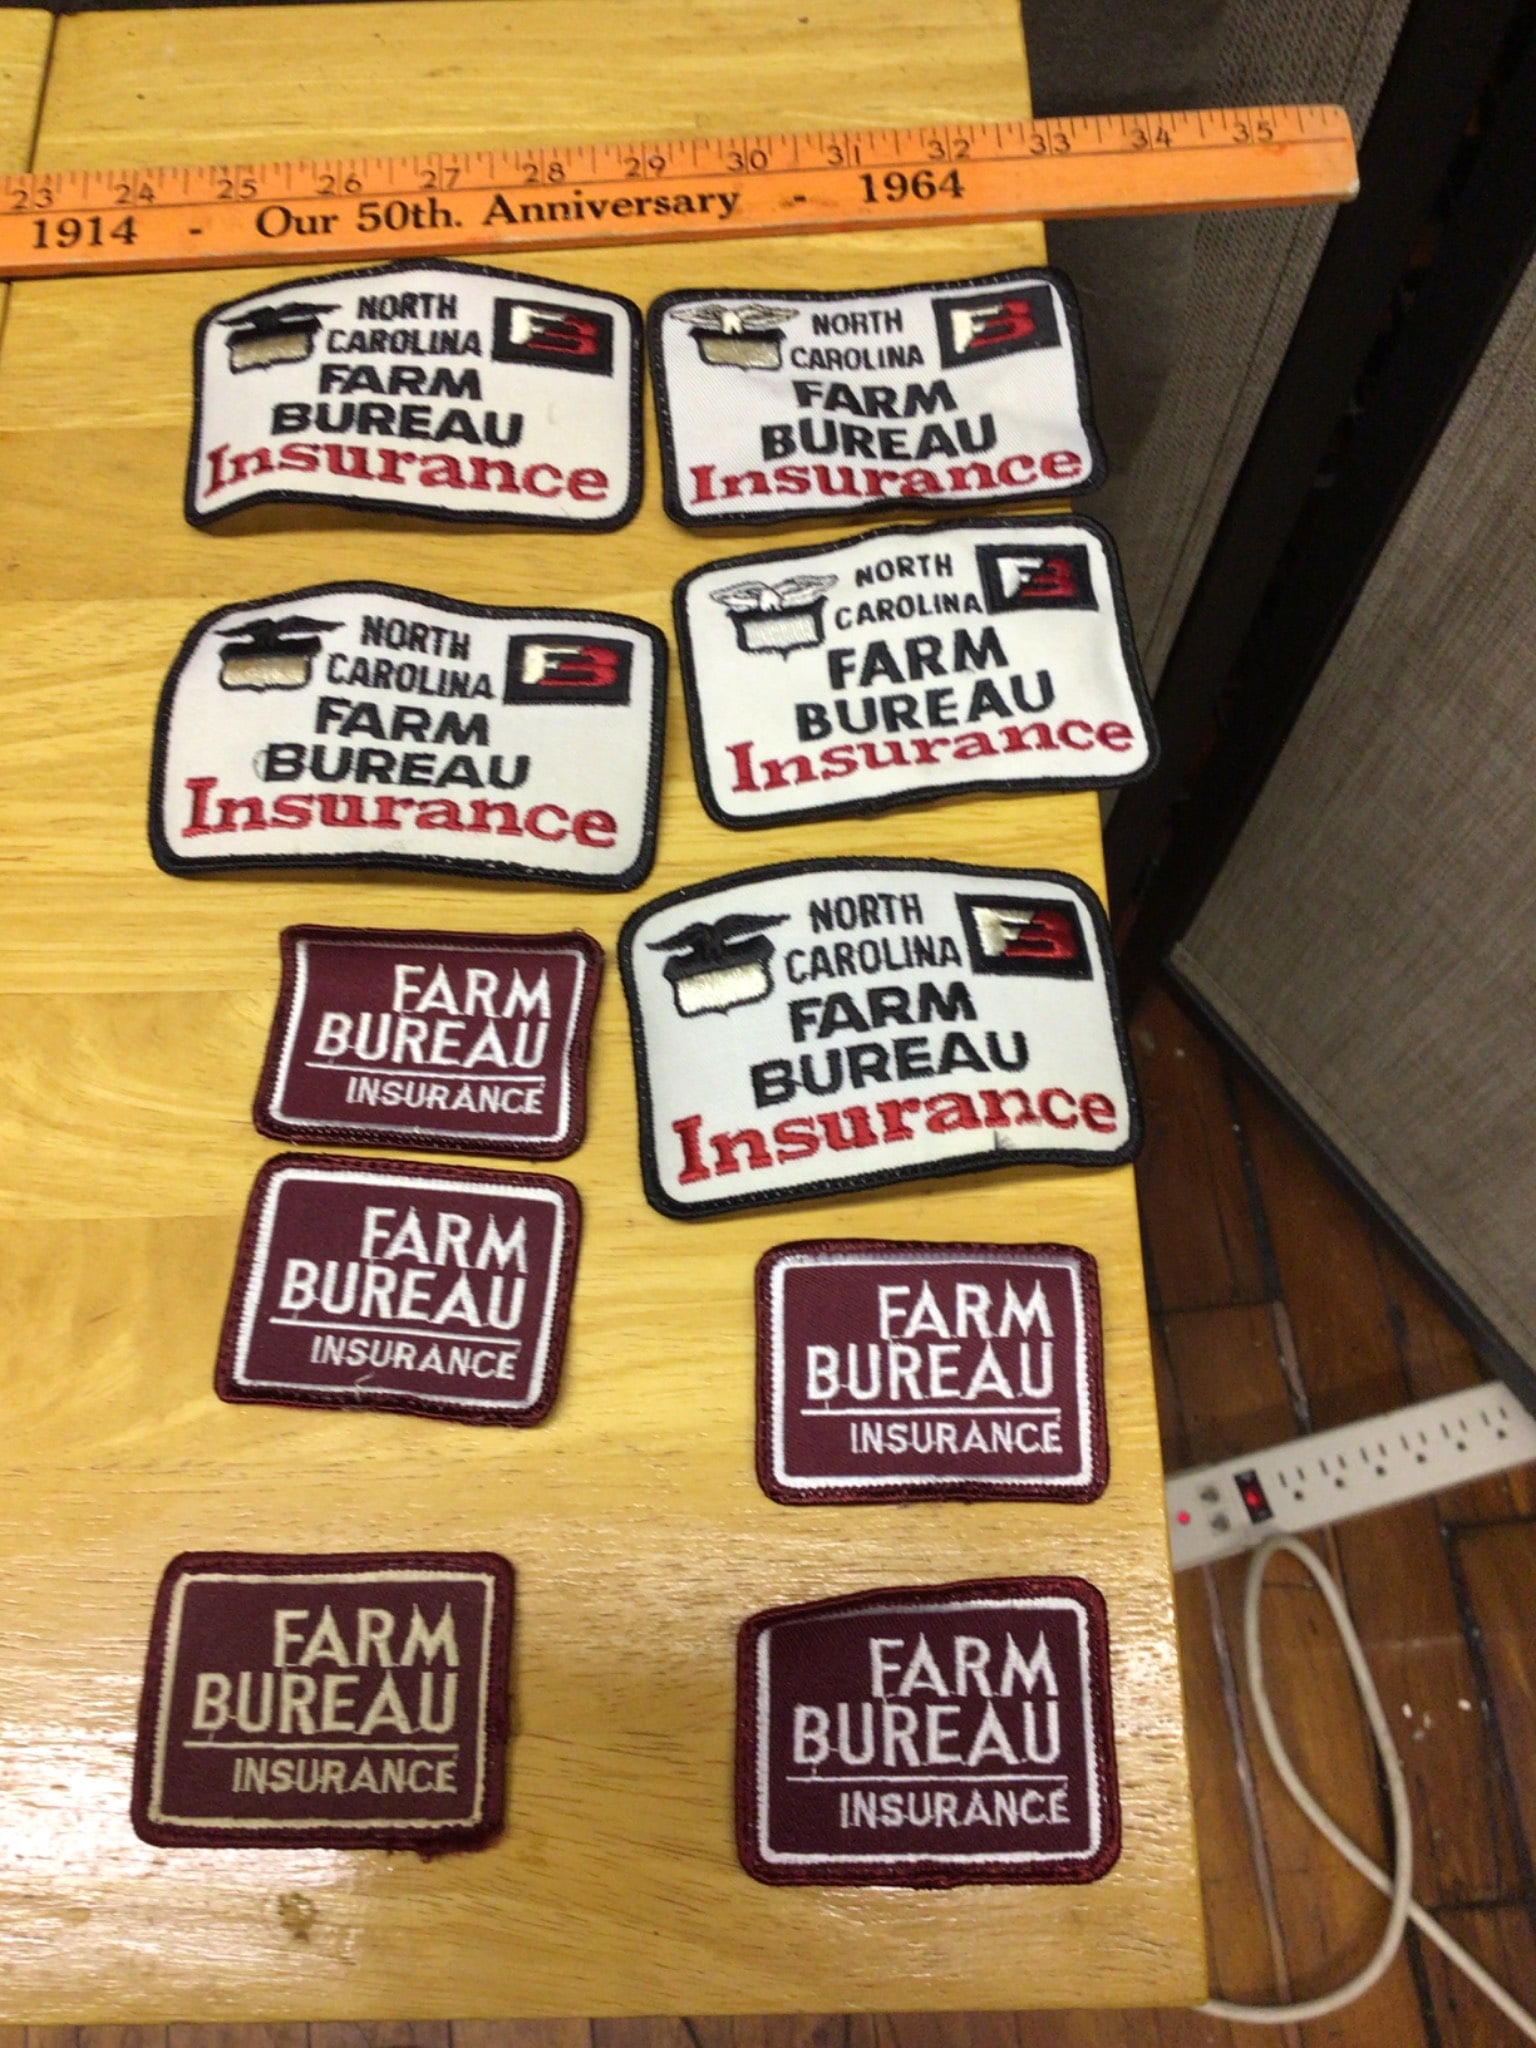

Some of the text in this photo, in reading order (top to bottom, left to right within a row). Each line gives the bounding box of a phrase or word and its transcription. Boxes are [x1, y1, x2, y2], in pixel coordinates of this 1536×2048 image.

[12, 120, 1273, 210] 23 24 25 26 27 28 29 30 31 32 33 34 35
[33, 218, 137, 248] 1914
[256, 205, 337, 239] Our
[356, 197, 462, 233] 50th.
[482, 189, 741, 225] Anniversary
[860, 170, 965, 204] 1964
[358, 292, 457, 321] NORTH
[812, 308, 902, 335] NORTH
[326, 328, 481, 356] CAROLINA
[791, 344, 924, 370] CAROLINA
[319, 364, 482, 401] FARM
[792, 380, 957, 418] FARM
[271, 402, 523, 447] BUREAU
[761, 413, 997, 461] BUREAU
[203, 442, 608, 500] Insurance
[689, 449, 1082, 504] Insurance
[855, 554, 952, 588] NORTH
[835, 592, 983, 631] CAROLINA
[361, 615, 470, 661] NORTH
[827, 626, 1009, 690] FARM
[326, 653, 495, 699] CAROLINA
[315, 697, 489, 746] FARM
[795, 670, 1056, 742] BUREAU
[264, 743, 531, 789] BUREAU
[726, 719, 1134, 793] Insurance
[181, 777, 617, 848] Insurance
[809, 893, 923, 933] NORTH
[785, 934, 962, 984] CAROLINA
[394, 962, 552, 1020] FARM
[787, 981, 979, 1043] FARM
[314, 1011, 549, 1070] BUREAU
[346, 1076, 543, 1114] INSURANCE
[750, 1030, 1029, 1109] BUREAU
[672, 1087, 1118, 1185] Insurance
[361, 1206, 528, 1274] FARM
[279, 1259, 527, 1330] BUREAU
[878, 1279, 1054, 1340] FARM
[311, 1335, 517, 1381] INSURANCE
[806, 1341, 1053, 1400] BUREAU
[850, 1419, 1062, 1454] INSURANCE
[274, 1602, 459, 1668] FARM
[870, 1630, 1059, 1698] FARM
[192, 1669, 458, 1736] BUREAU
[793, 1701, 1060, 1767] BUREAU
[232, 1756, 457, 1795] INSURANCE
[840, 1788, 1070, 1828] INSURANCE
